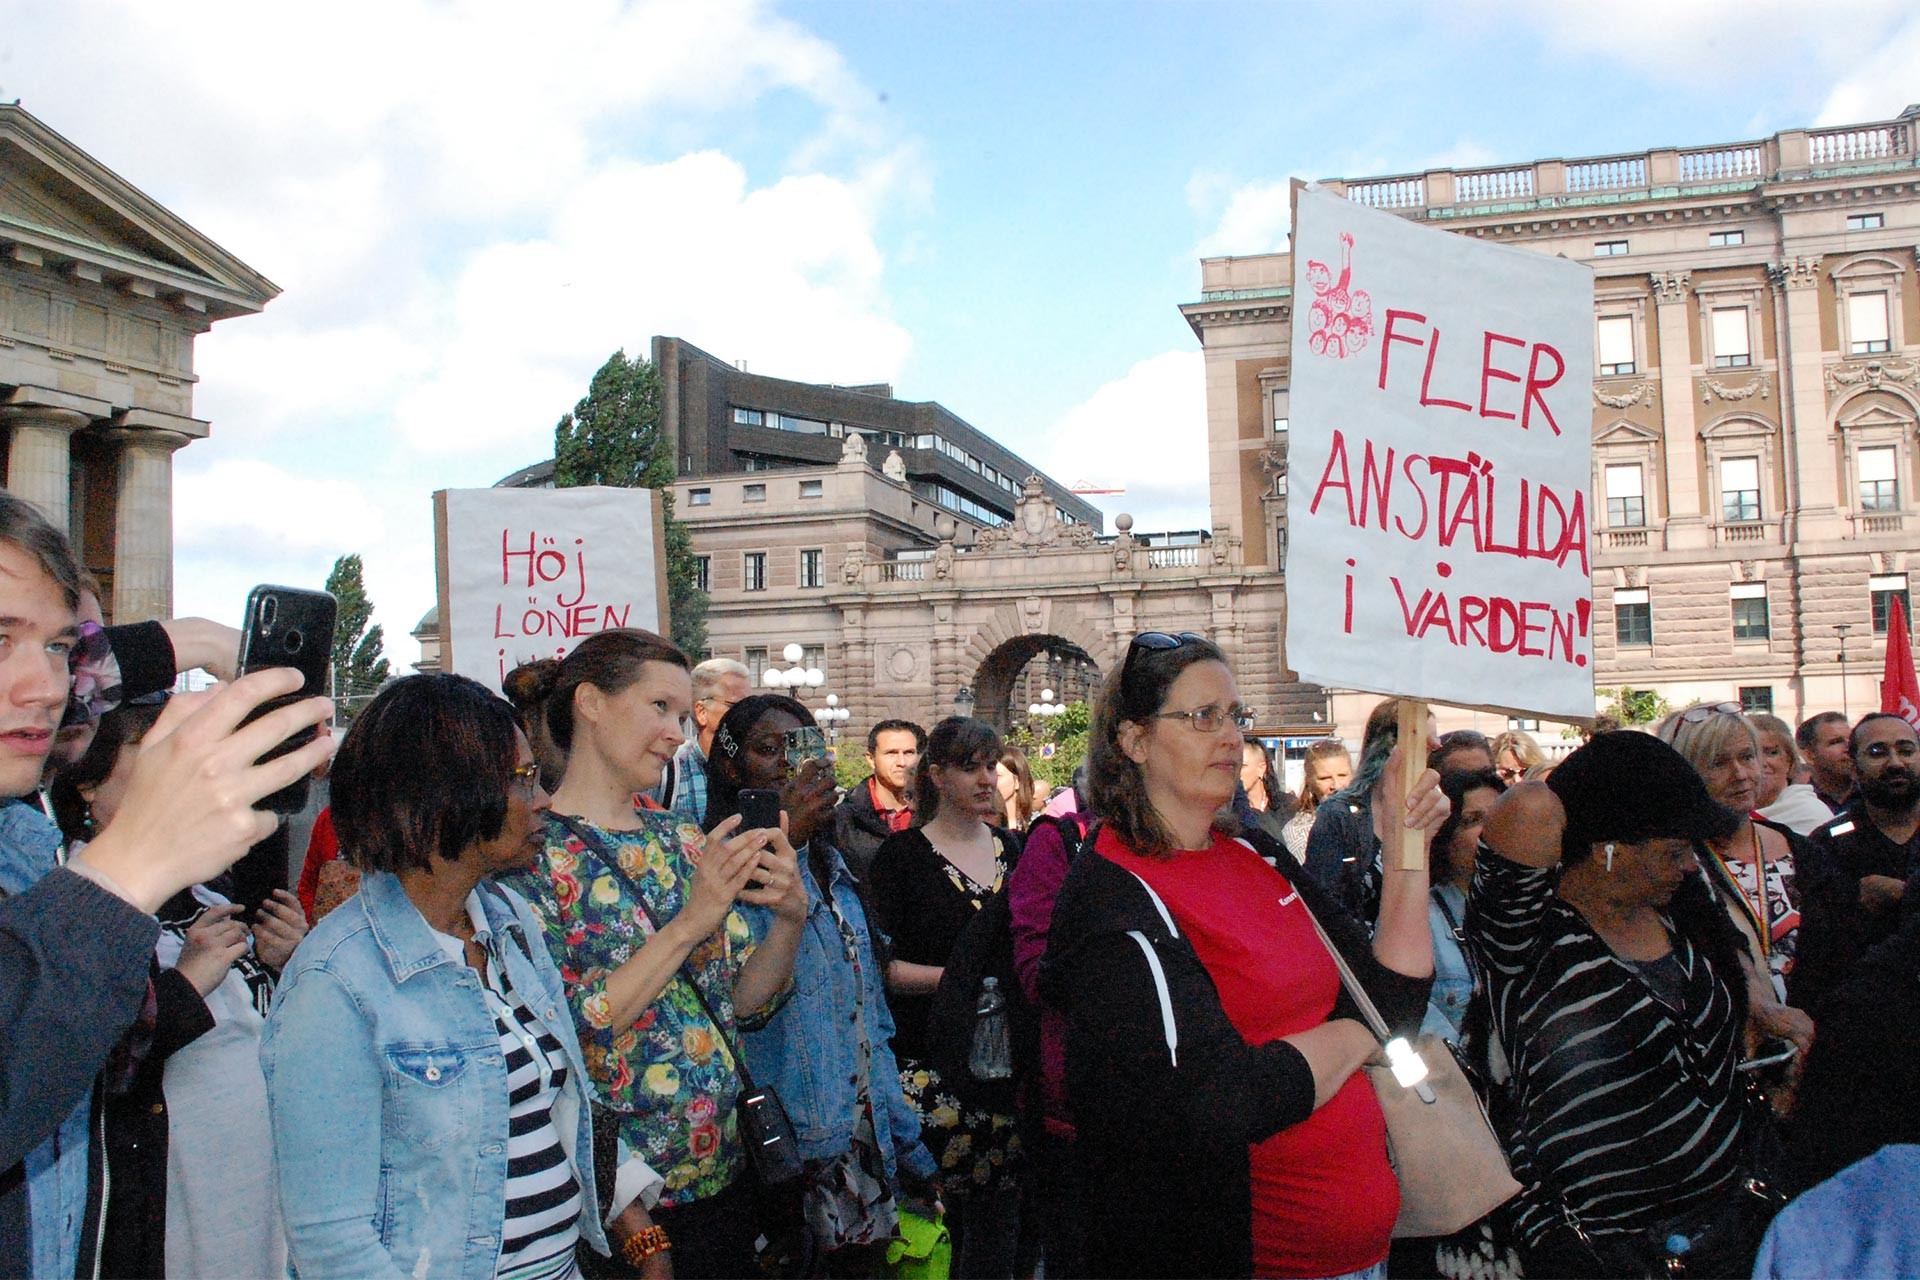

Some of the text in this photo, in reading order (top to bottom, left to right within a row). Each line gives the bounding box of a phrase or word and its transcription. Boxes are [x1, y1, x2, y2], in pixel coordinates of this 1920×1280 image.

[1378, 308, 1566, 436] FLER
[1309, 428, 1590, 578] ANSTÄLLDA
[494, 596, 631, 639] LÖNEN
[502, 528, 587, 608] Höj
[1344, 558, 1592, 668] i VÅRDEN!
